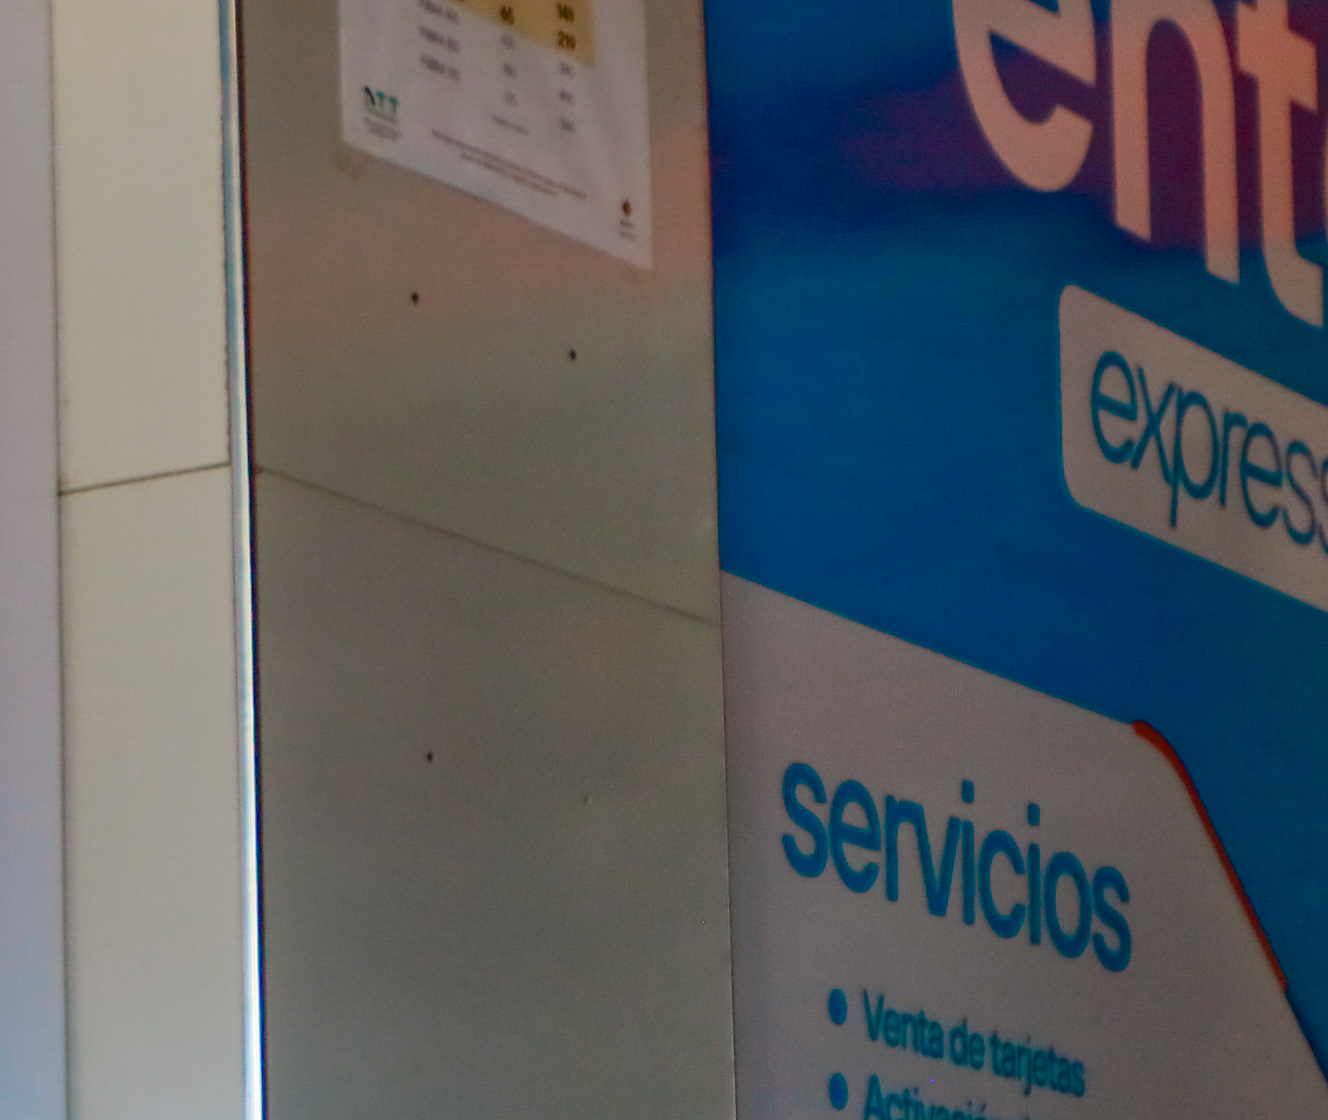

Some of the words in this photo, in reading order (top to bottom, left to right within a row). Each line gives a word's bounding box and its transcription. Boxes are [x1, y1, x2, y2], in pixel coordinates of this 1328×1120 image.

[781, 762, 1133, 972] servicios
[863, 988, 944, 1060] Venta
[949, 1015, 986, 1070] de
[990, 1030, 1086, 1097] tarjetas
